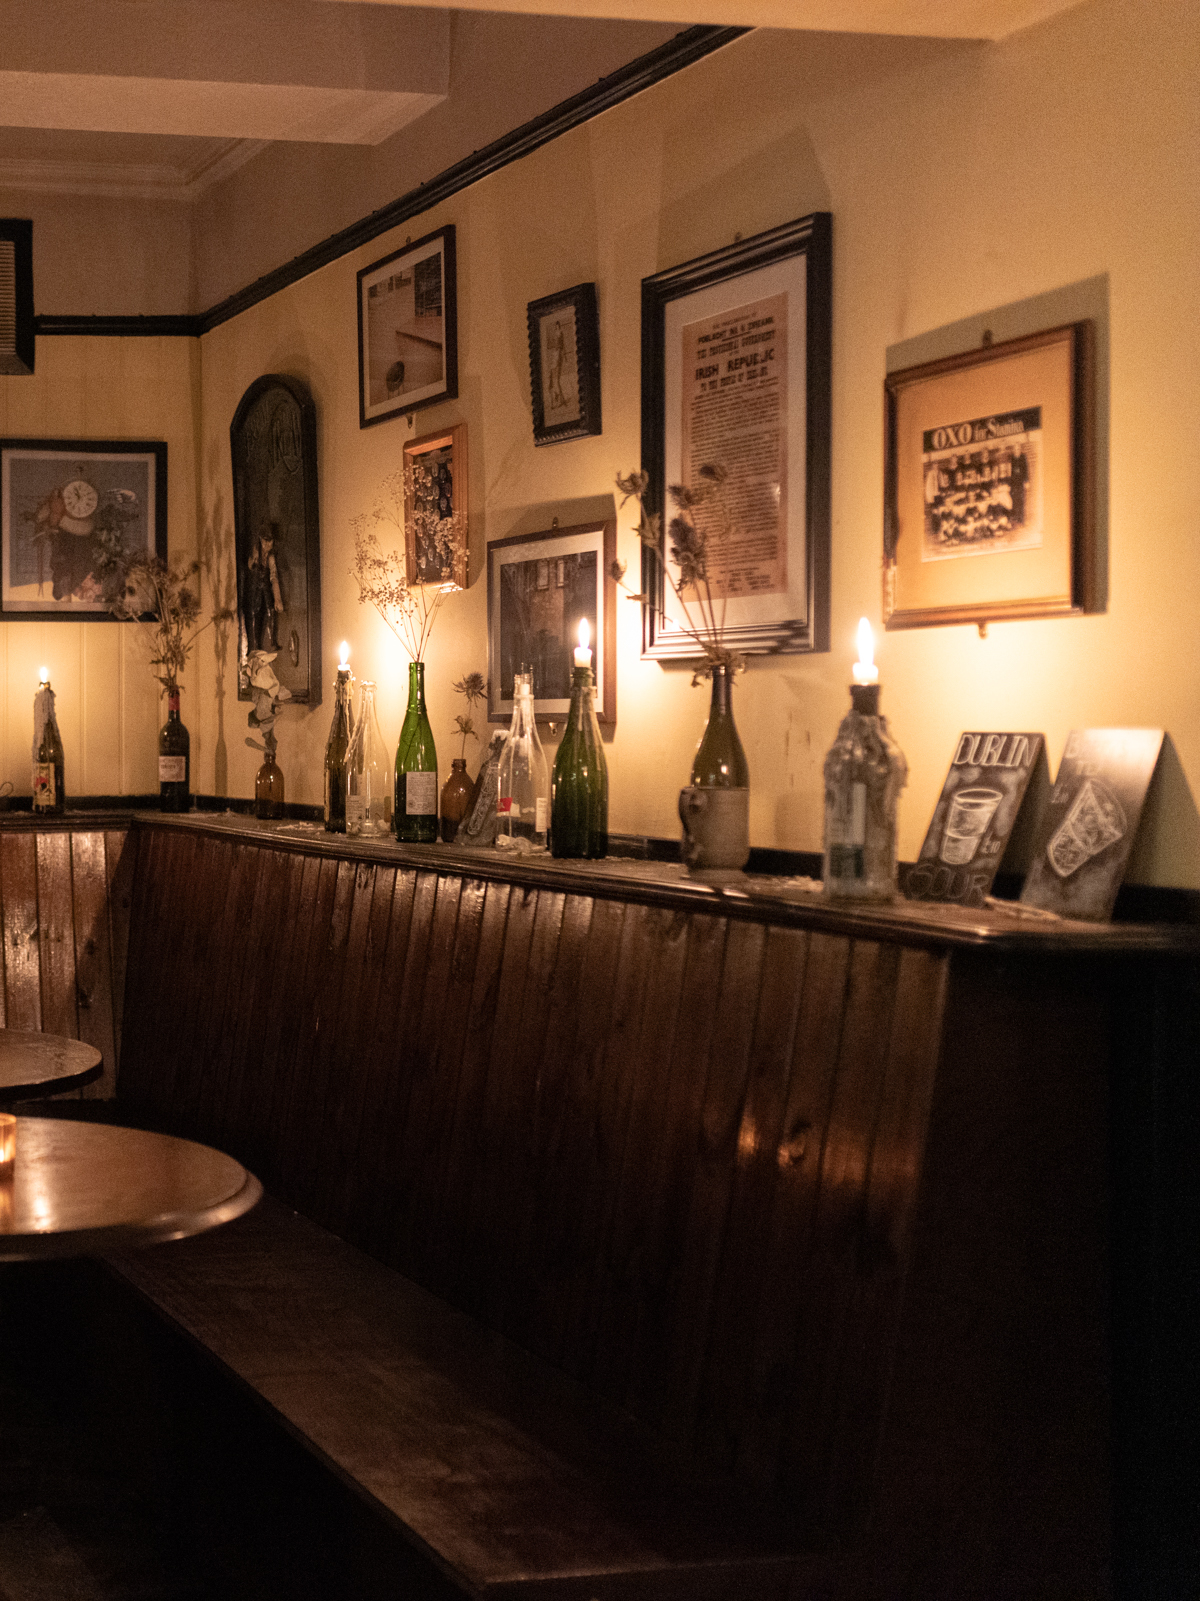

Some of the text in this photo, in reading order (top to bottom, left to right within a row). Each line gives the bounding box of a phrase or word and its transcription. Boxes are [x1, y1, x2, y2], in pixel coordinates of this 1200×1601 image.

[695, 363, 719, 380] IRISH
[932, 423, 972, 450] OXO
[986, 418, 1025, 440] Stamina
[953, 733, 1041, 767] DUBLIN
[906, 862, 990, 906] SOUR
